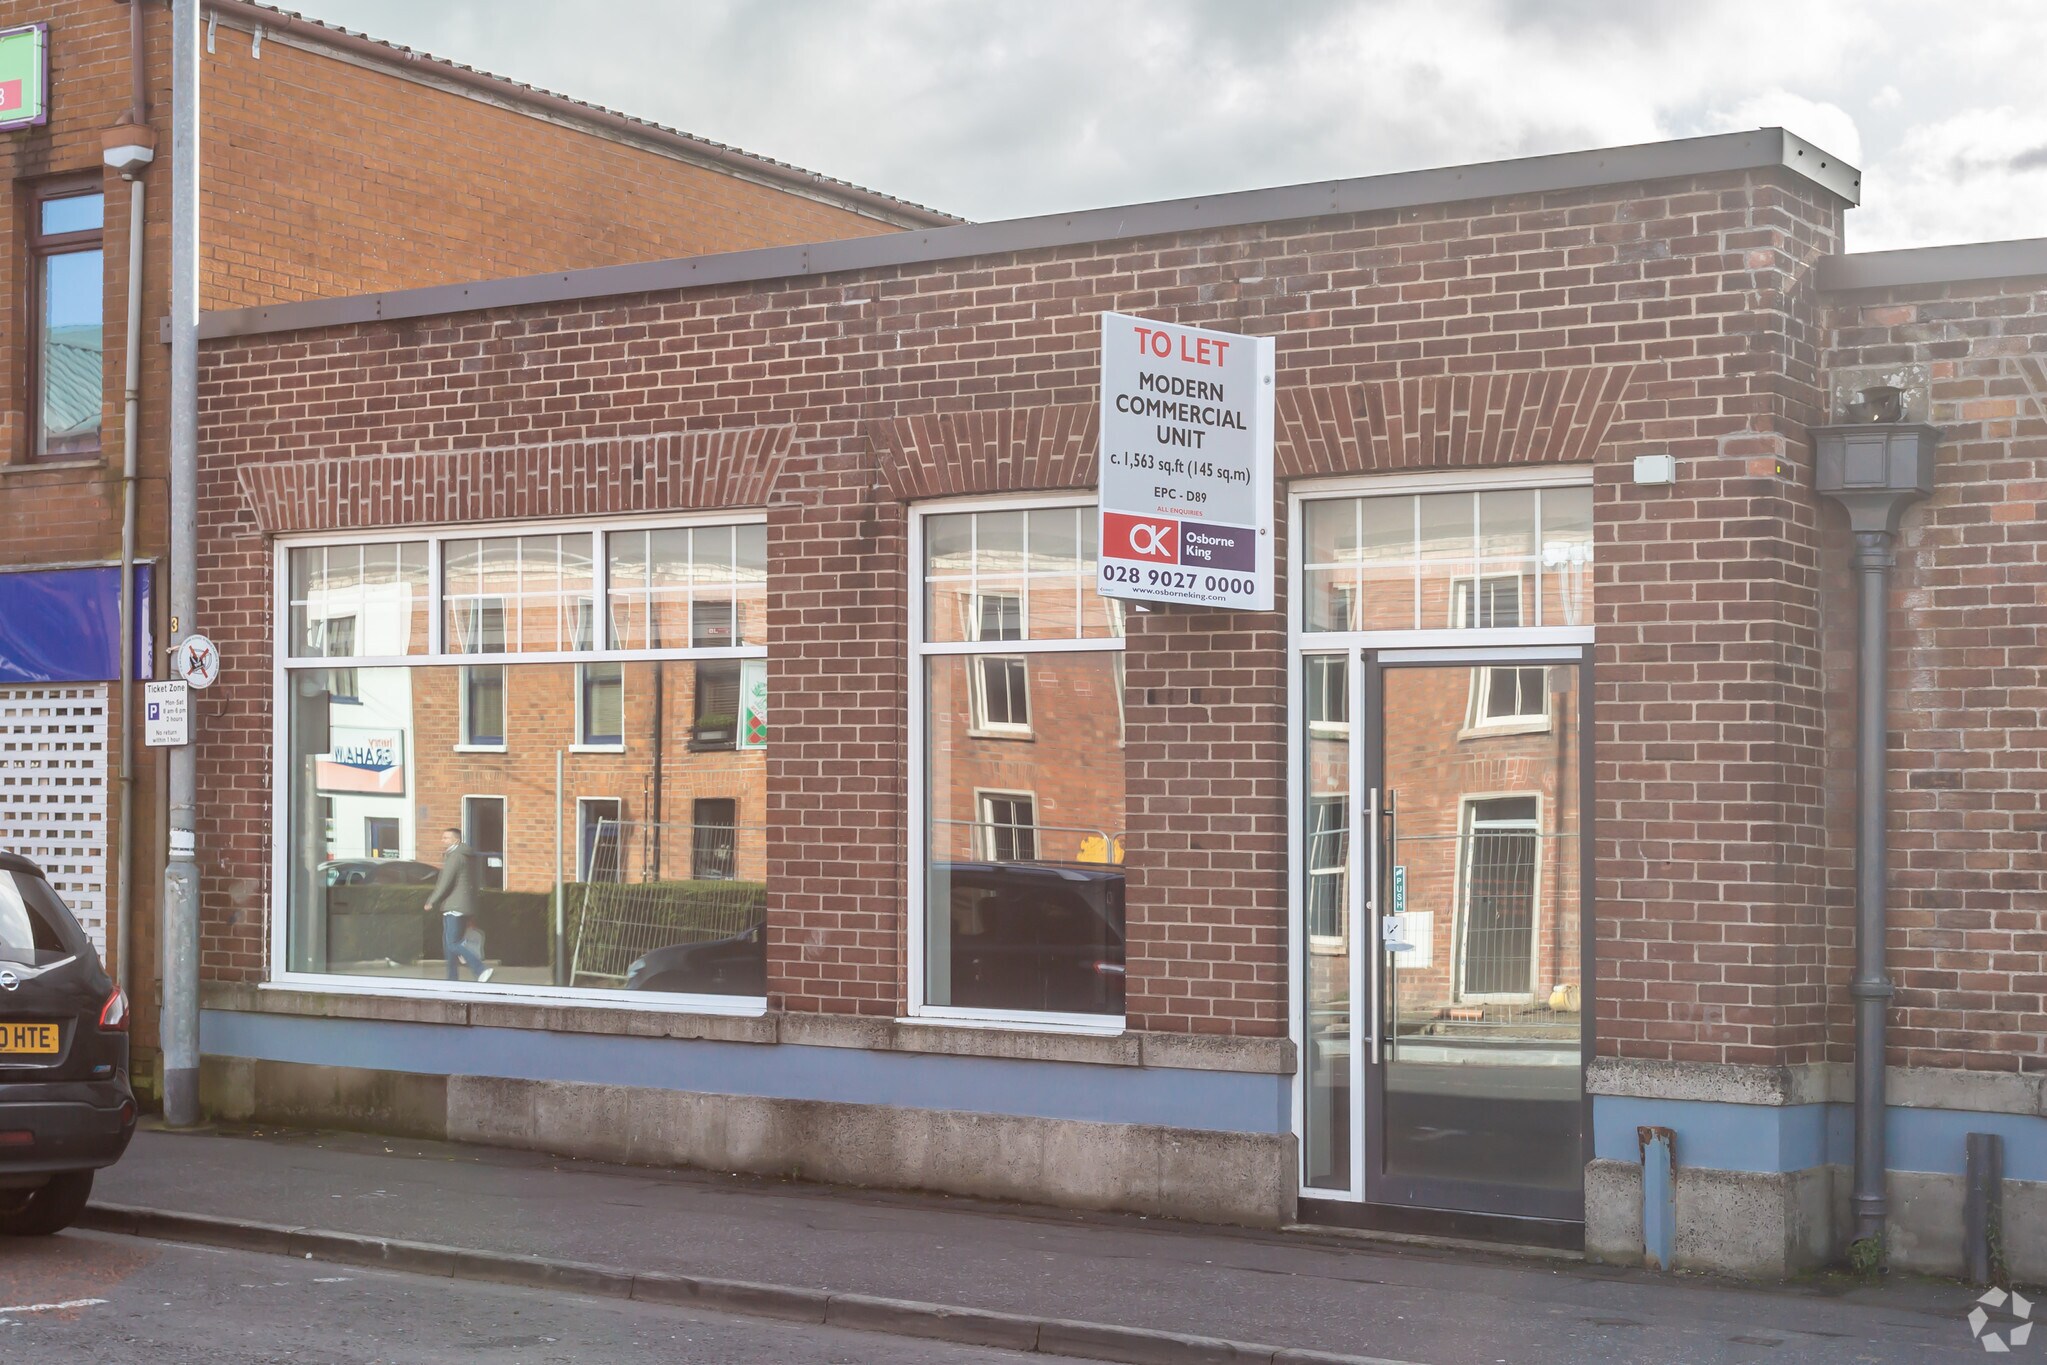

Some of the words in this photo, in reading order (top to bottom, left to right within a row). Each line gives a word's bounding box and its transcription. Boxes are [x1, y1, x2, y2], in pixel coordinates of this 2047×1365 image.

[1134, 326, 1172, 358] TO
[1181, 335, 1230, 367] LET
[1139, 372, 1224, 402] MODERN
[1116, 394, 1247, 430] COMMERCIAL
[1157, 425, 1205, 449] UNIT
[1110, 453, 1120, 465] c.
[1124, 451, 1154, 469] 1,563
[1158, 459, 1184, 476] sq.ft
[1187, 460, 1213, 479] (145
[1217, 467, 1251, 486] sq.m)
[1154, 486, 1177, 499] EPC
[1186, 490, 1207, 503] D89
[1170, 507, 1204, 517] ENQUIRIES
[1129, 523, 1172, 557] OK
[1186, 531, 1235, 548] Osborne
[1186, 544, 1212, 561] King
[1103, 564, 1140, 584] 028
[1148, 569, 1198, 589] 9027
[1205, 575, 1255, 595] 0000
[1132, 586, 1226, 602] www.osborneking.com
[147, 684, 167, 693] Ticket
[169, 683, 185, 692] Zone
[150, 704, 158, 719] P
[14, 1026, 51, 1048] HTE
